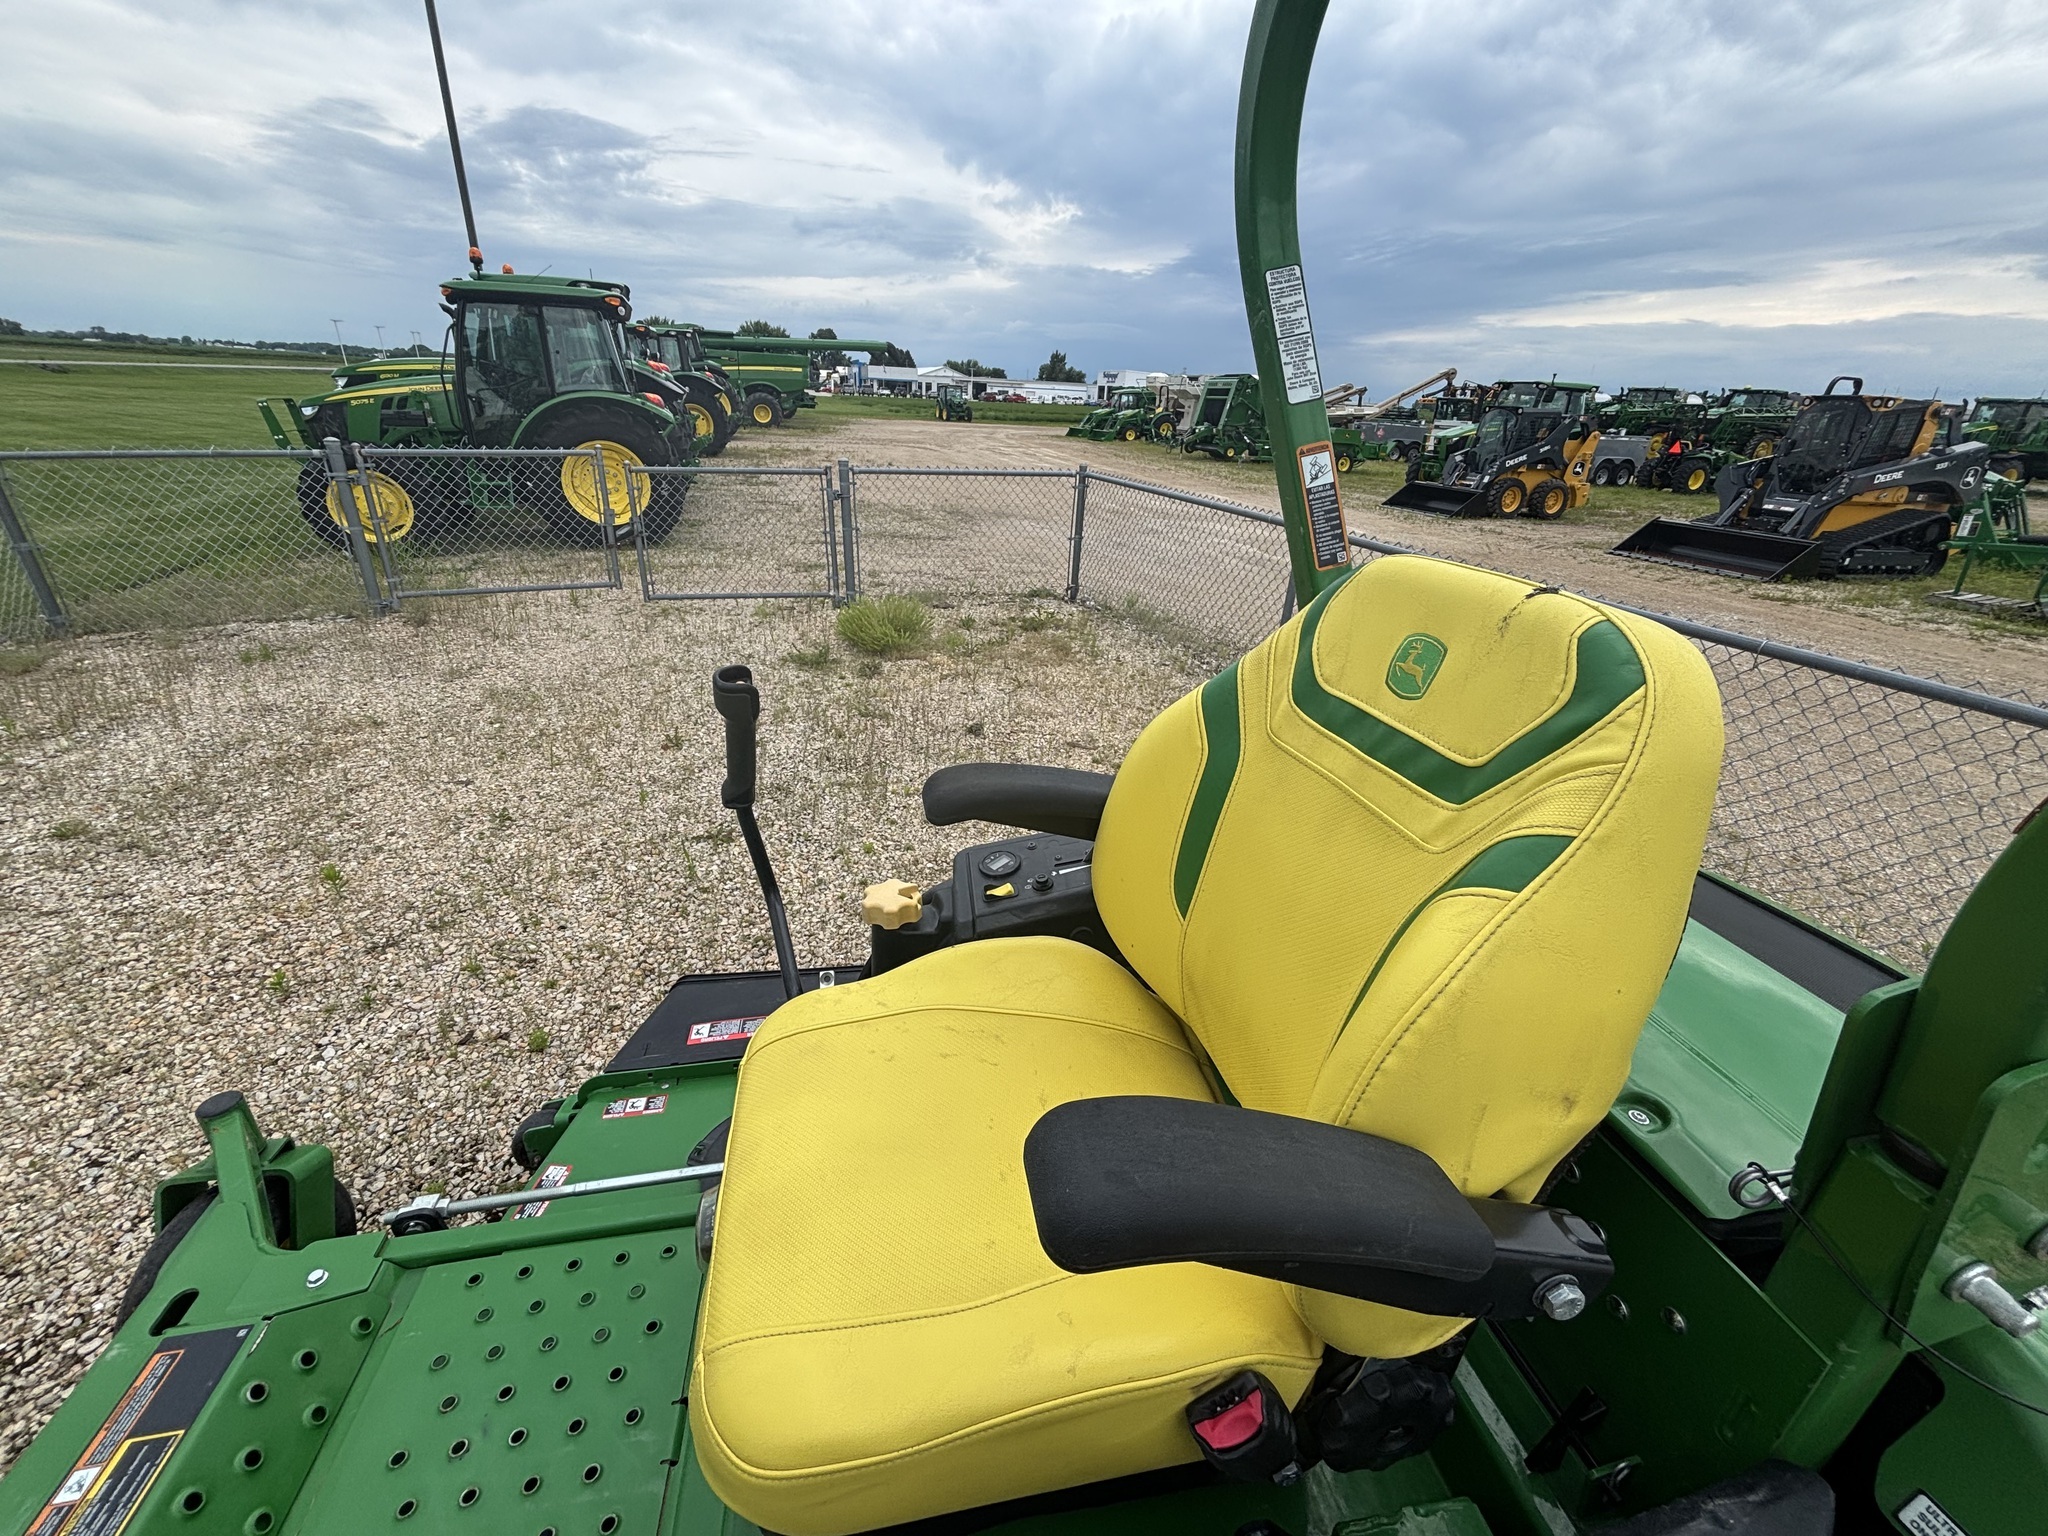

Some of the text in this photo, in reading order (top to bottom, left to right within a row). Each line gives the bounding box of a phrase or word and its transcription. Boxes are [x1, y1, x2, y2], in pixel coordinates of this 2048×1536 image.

[1271, 272, 1296, 281] PROTECTORA
[1506, 454, 1528, 467] DEERE
[1873, 470, 1905, 484] DEERE
